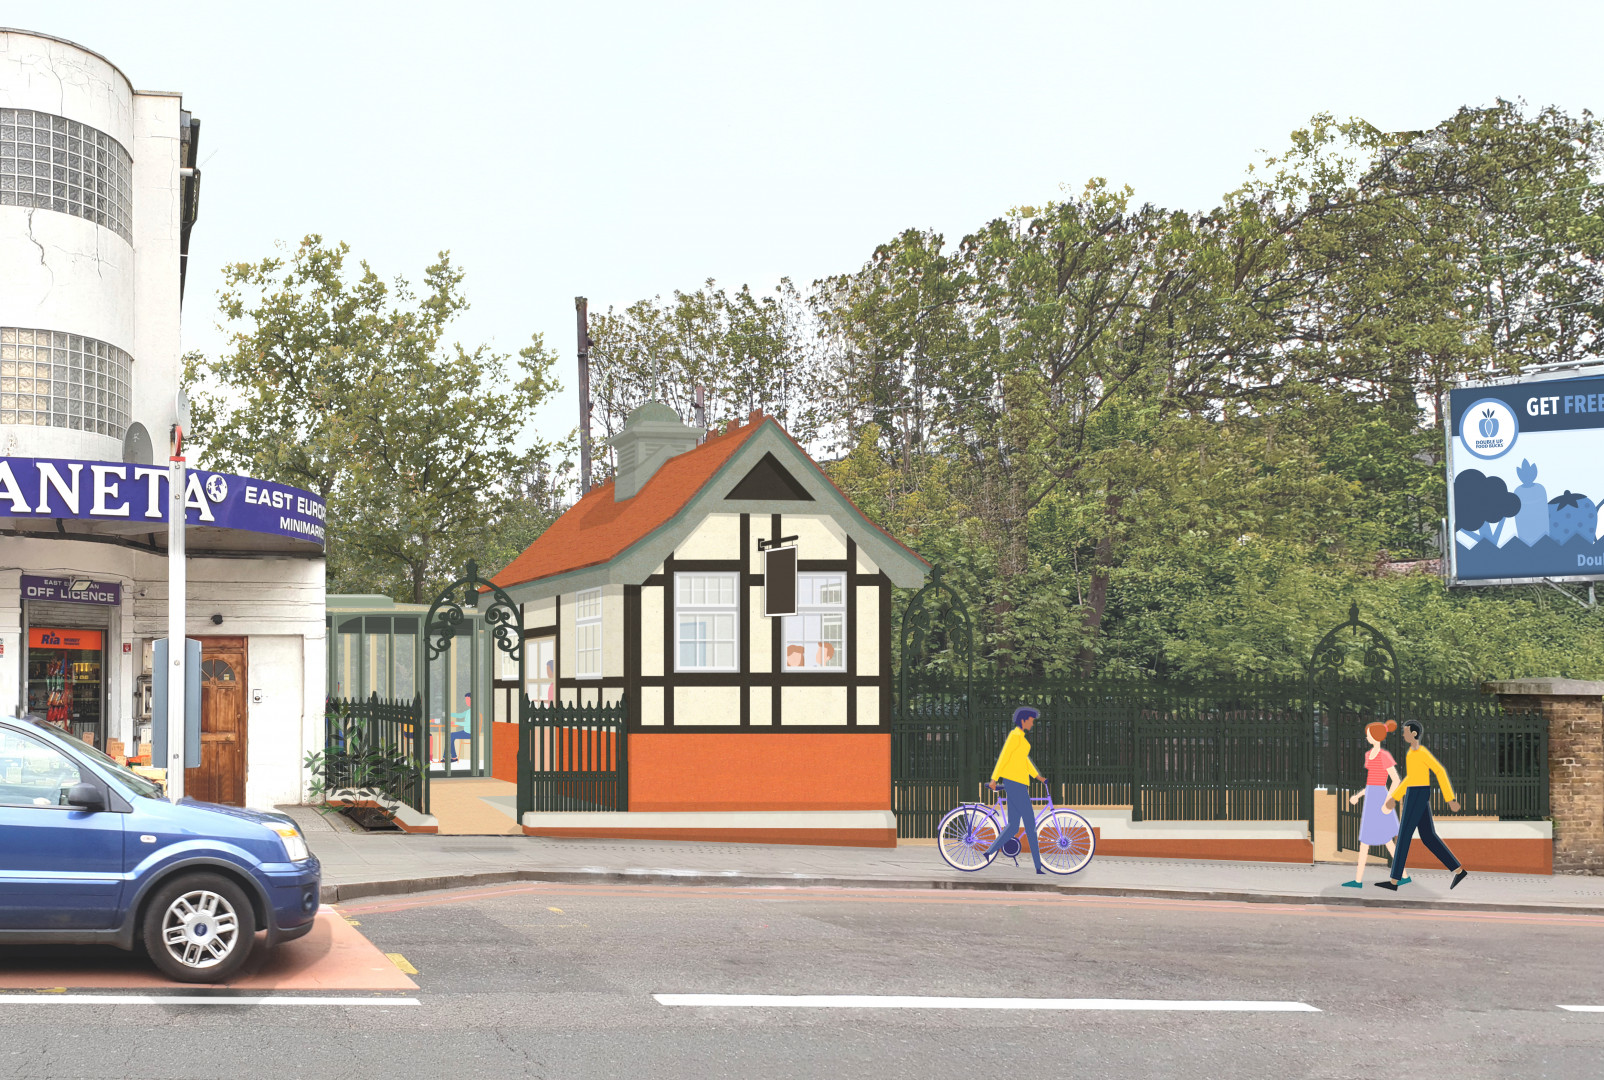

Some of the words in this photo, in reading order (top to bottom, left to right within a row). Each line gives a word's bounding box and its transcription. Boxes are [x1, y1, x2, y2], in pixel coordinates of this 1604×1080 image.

[1526, 396, 1560, 417] GET
[1564, 393, 1604, 415] FREE
[245, 486, 293, 510] EAST
[1577, 552, 1604, 567] Dou
[27, 586, 54, 597] OFF
[60, 589, 115, 602] LICENCE
[41, 631, 60, 645] Ria
